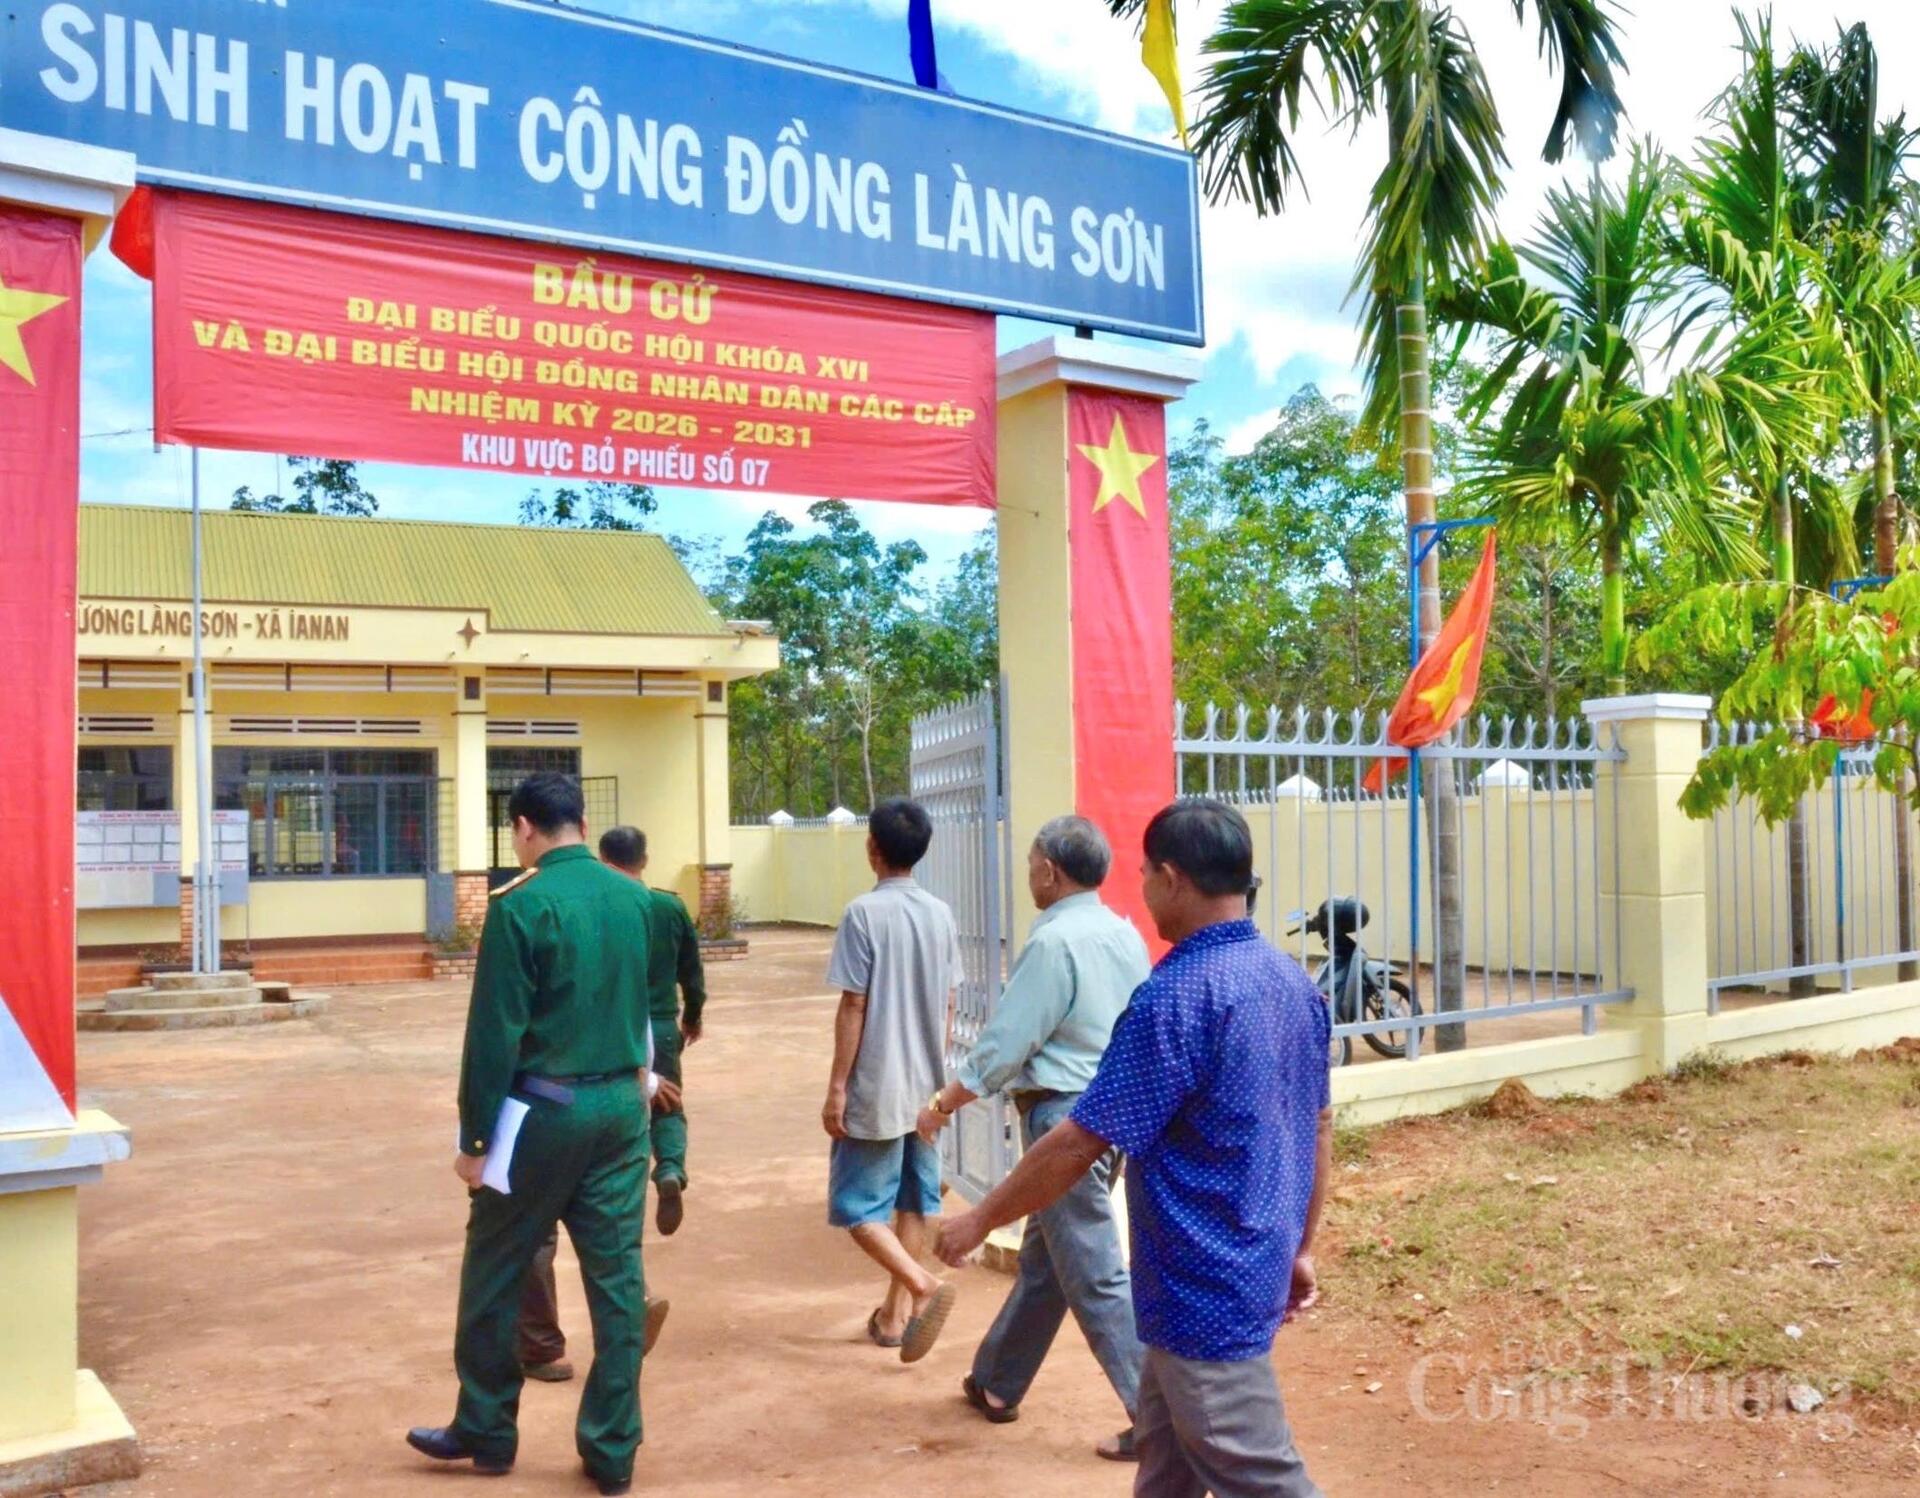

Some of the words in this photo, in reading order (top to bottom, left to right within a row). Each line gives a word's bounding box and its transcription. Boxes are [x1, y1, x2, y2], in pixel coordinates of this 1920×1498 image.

[39, 2, 248, 132] SINH
[285, 50, 488, 181] HOẠT
[519, 85, 703, 210] CỘNG
[724, 118, 891, 241] ĐỒNG
[914, 163, 1055, 271] LÀNG
[1071, 206, 1165, 291] SƠN
[533, 257, 633, 314] BẦU
[649, 273, 719, 325] CỬ
[346, 296, 417, 331] ĐẠI
[430, 304, 520, 341] BIỂU
[533, 320, 633, 354] QUỐC
[645, 333, 704, 365] HỘI
[715, 343, 806, 375] KHÓA
[816, 355, 869, 382] XVI
[192, 319, 250, 352] VÀ
[264, 329, 337, 364] ĐẠI
[352, 336, 445, 372] BIỂU
[458, 350, 523, 384] HỘI
[536, 358, 639, 393] ĐỒNG
[650, 373, 749, 405] NHÂN
[760, 384, 830, 413] DÂN
[839, 394, 903, 421] CÁC
[913, 399, 975, 428] CẤP
[410, 387, 540, 424] NHIỆM
[552, 400, 600, 428] KỲ
[611, 408, 698, 437] 2026
[733, 420, 811, 448] 2031
[461, 433, 516, 467] KHU
[524, 438, 573, 475] VỰC
[582, 436, 615, 474] BỎ
[623, 443, 695, 481] PHIẾU
[703, 447, 736, 484] SỐ
[741, 459, 770, 486] 07
[138, 604, 192, 637] LÀNG
[200, 608, 238, 638] SƠN
[256, 608, 282, 640] XÃ
